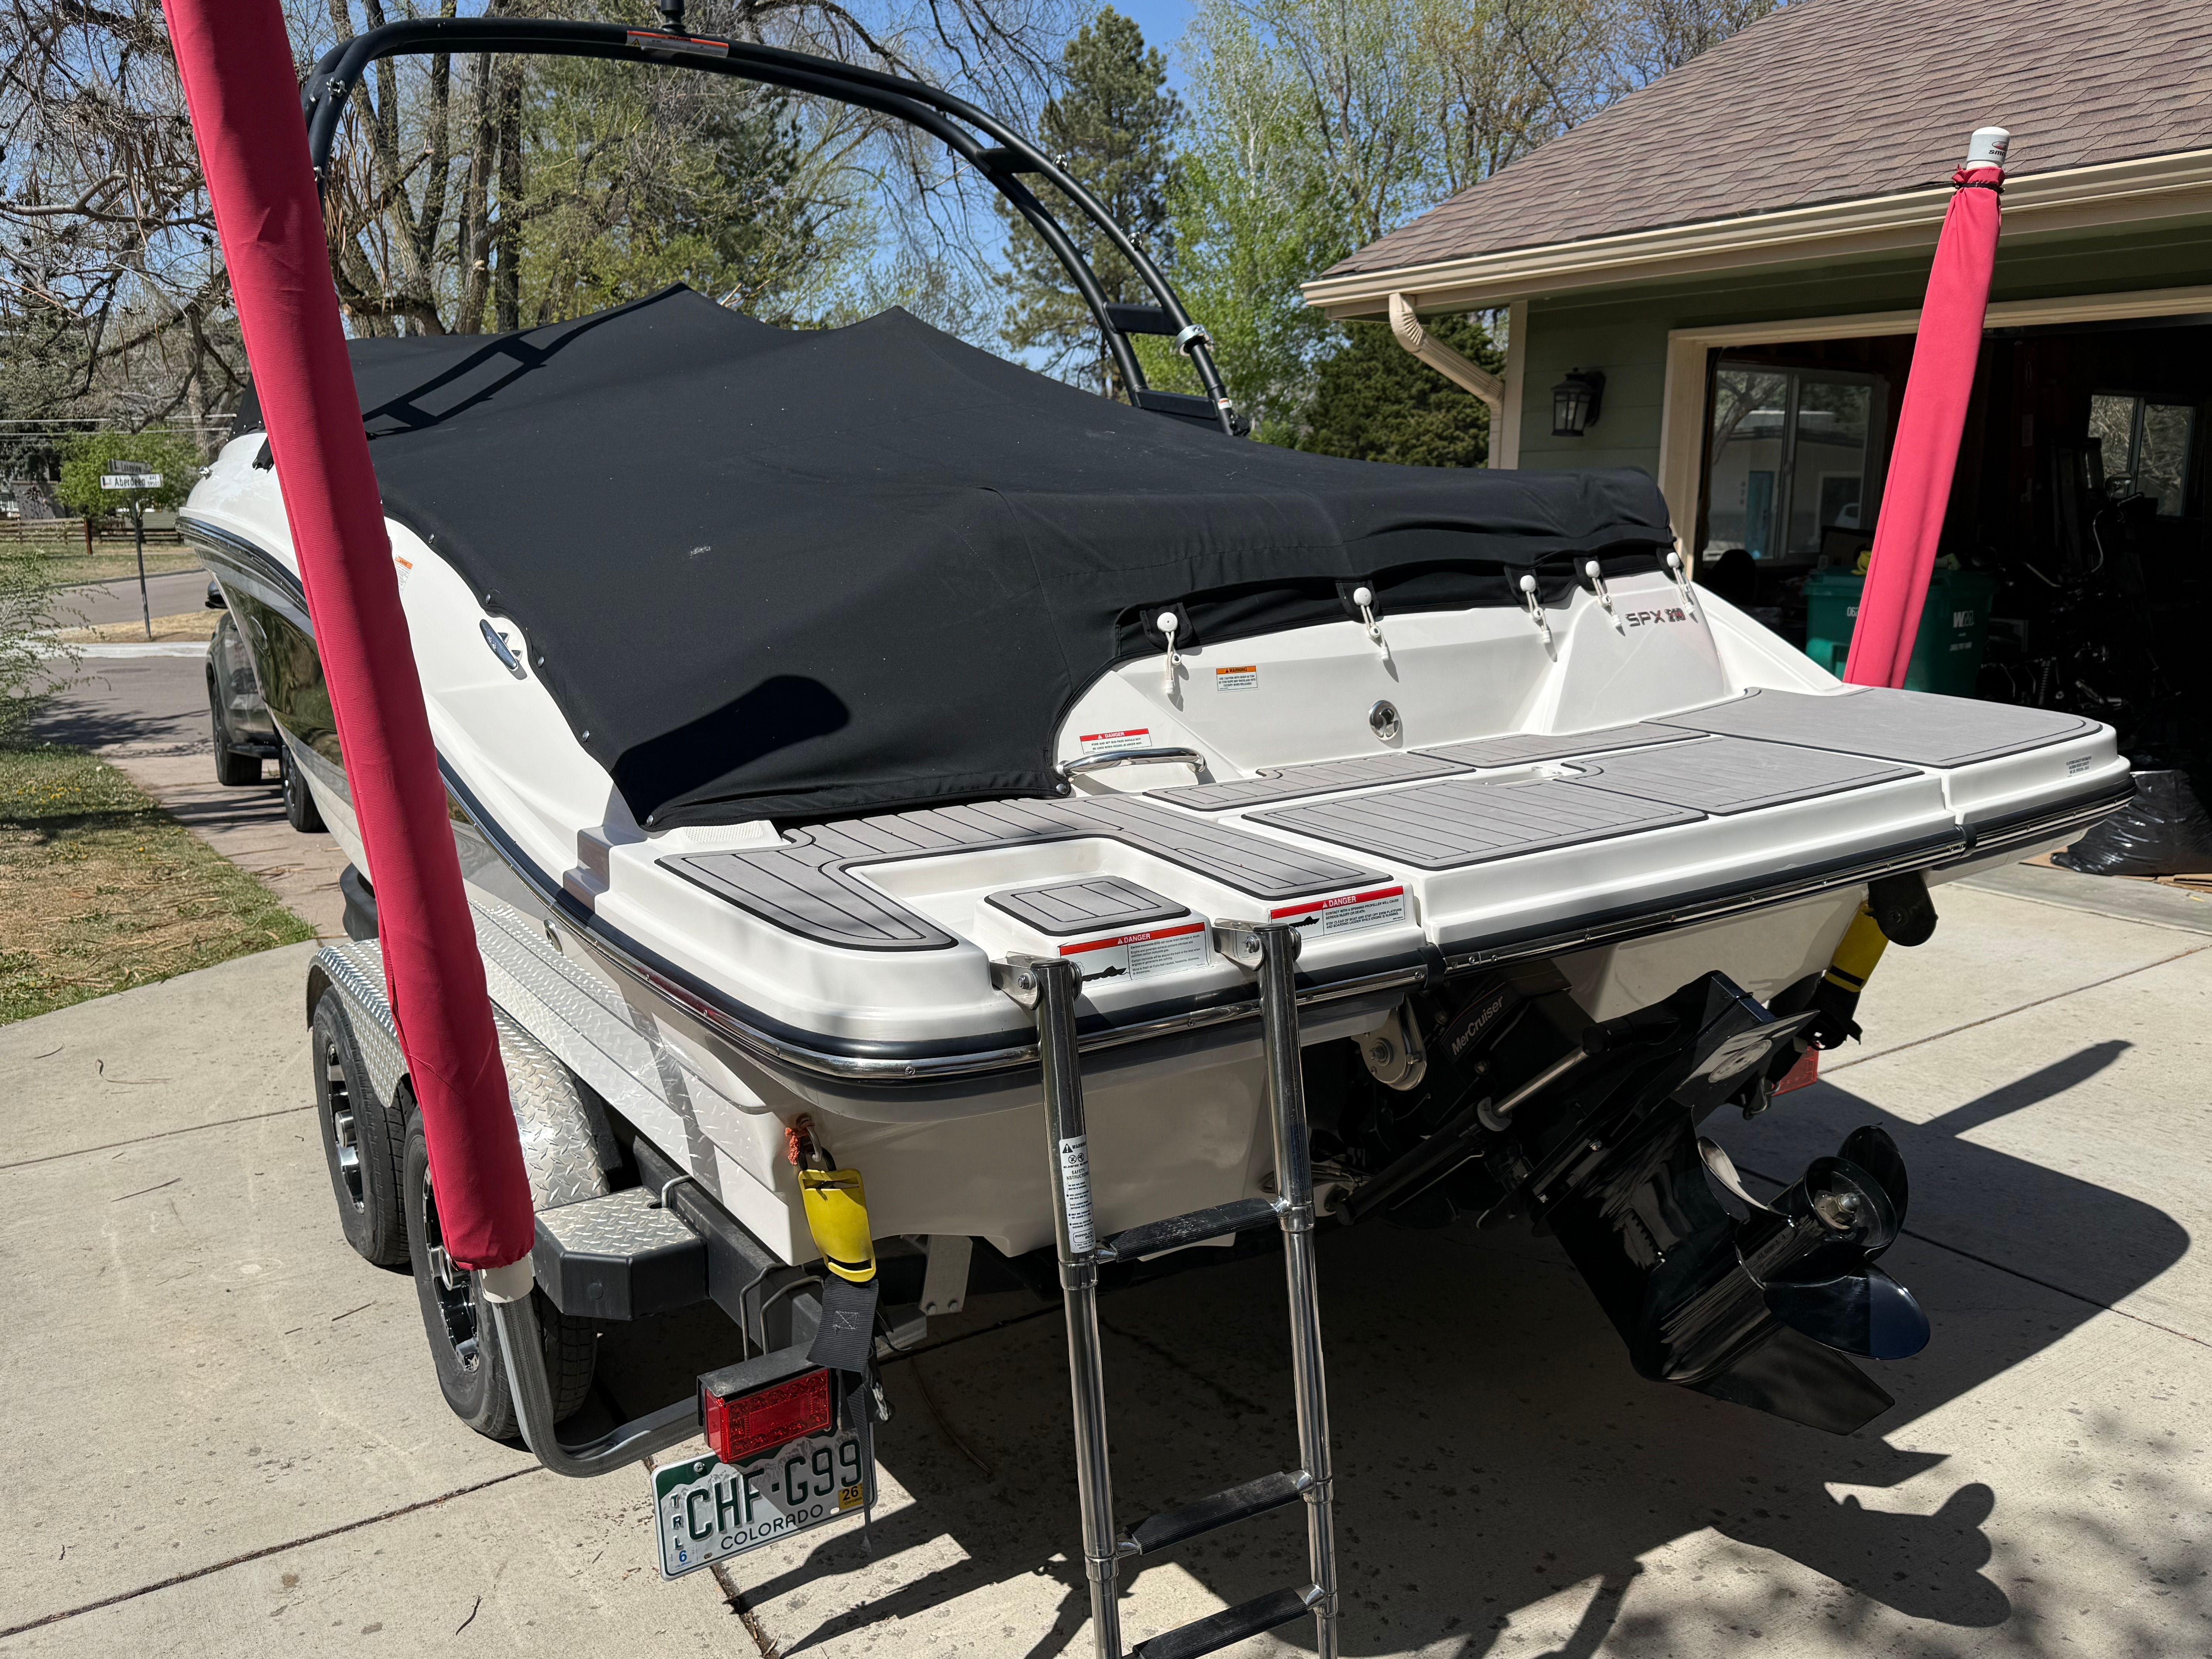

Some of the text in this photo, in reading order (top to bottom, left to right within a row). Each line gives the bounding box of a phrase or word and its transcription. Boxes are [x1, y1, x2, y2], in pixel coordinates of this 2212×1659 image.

[115, 477, 146, 487] Aberdeen
[1625, 610, 1665, 627] SPX
[1954, 610, 1974, 628] WM
[1329, 896, 1356, 907] DANGER
[1124, 933, 1151, 943] DANGER
[1451, 996, 1503, 1055] MerCruiser
[842, 1486, 859, 1501] 26
[721, 1504, 823, 1549] COLORADO
[679, 1550, 687, 1562] 6
